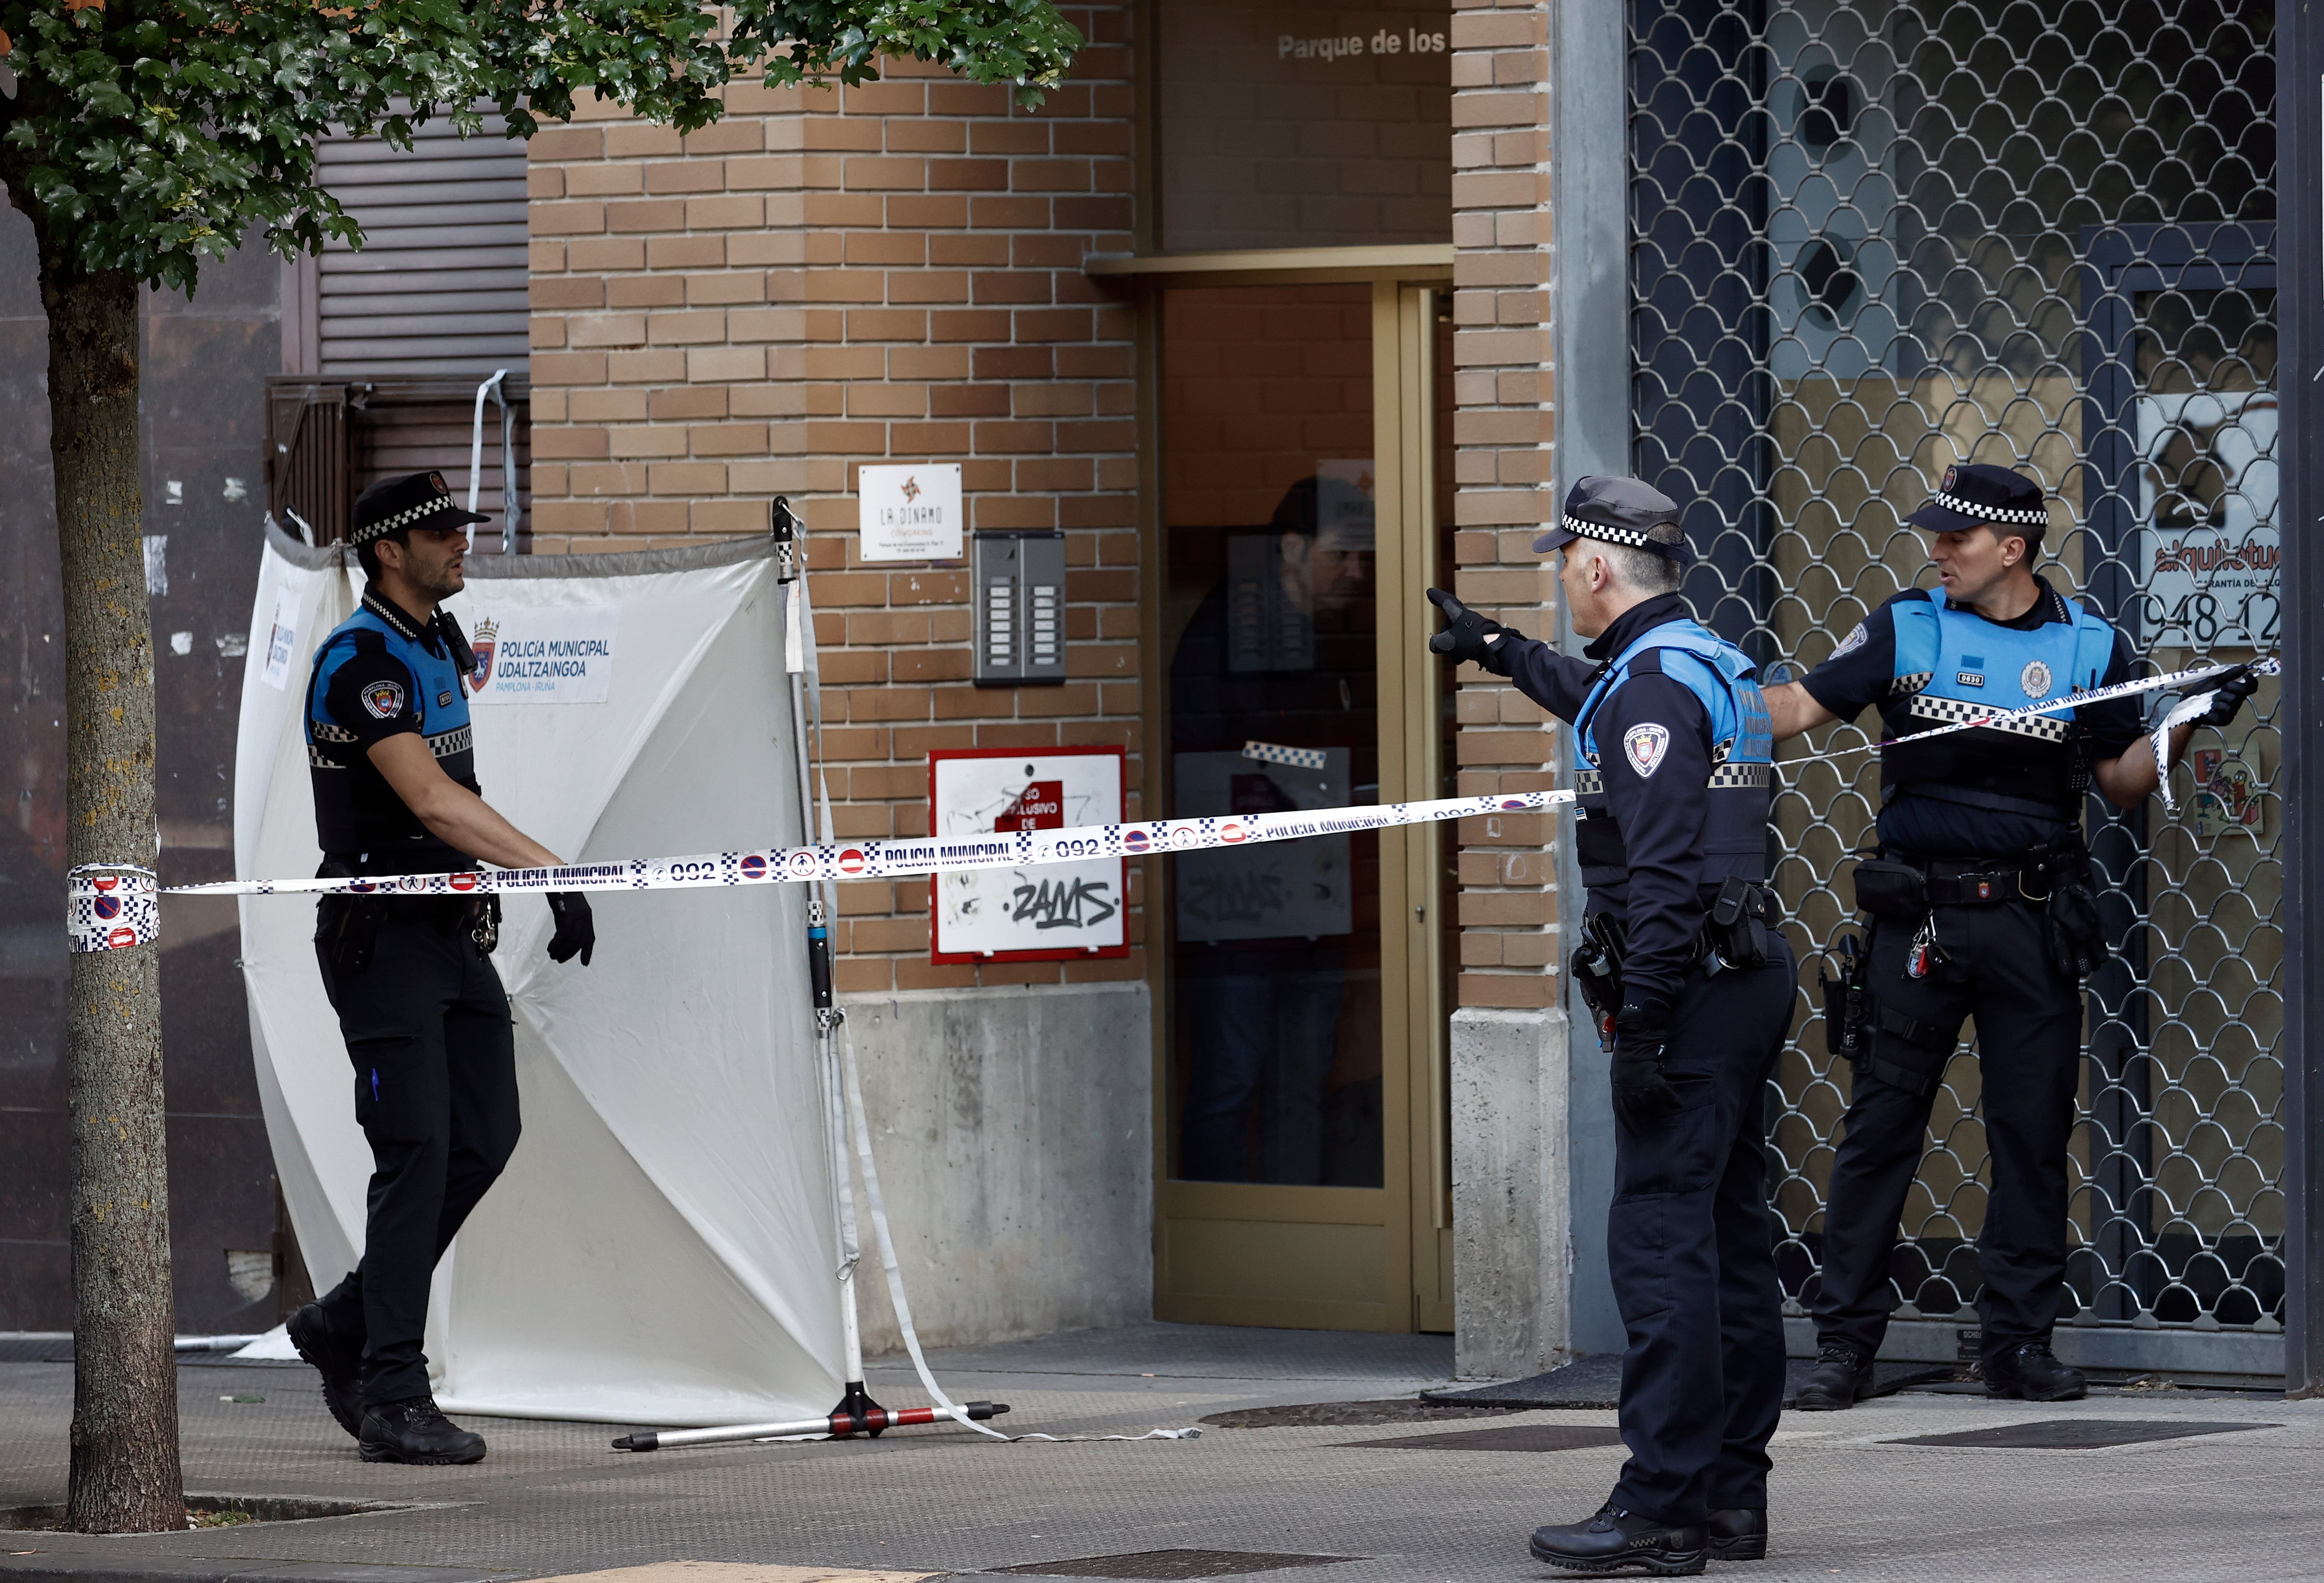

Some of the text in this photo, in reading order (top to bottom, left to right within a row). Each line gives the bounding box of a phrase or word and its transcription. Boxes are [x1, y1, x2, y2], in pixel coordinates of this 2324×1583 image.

[1278, 27, 1446, 62] Parque de los
[880, 506, 943, 526] LA DINAMO
[2144, 593, 2217, 642] 948
[548, 640, 609, 658] MUNICIPAL
[498, 660, 586, 678] UDALTZAINGOA
[495, 679, 555, 693] PAMPLONA IRUÑA
[1961, 675, 1980, 683] 0630
[1625, 728, 1646, 741] PAMPLONA
[1017, 801, 1058, 816] LUSIVO
[1021, 818, 1037, 830] DE
[1266, 820, 1317, 838] POLICIA
[1319, 813, 1390, 834] MUNICIPAL
[885, 838, 1101, 869] POLICIA MUNICIPAL 092
[496, 862, 716, 889] POLICIA MUNICIPAL 092
